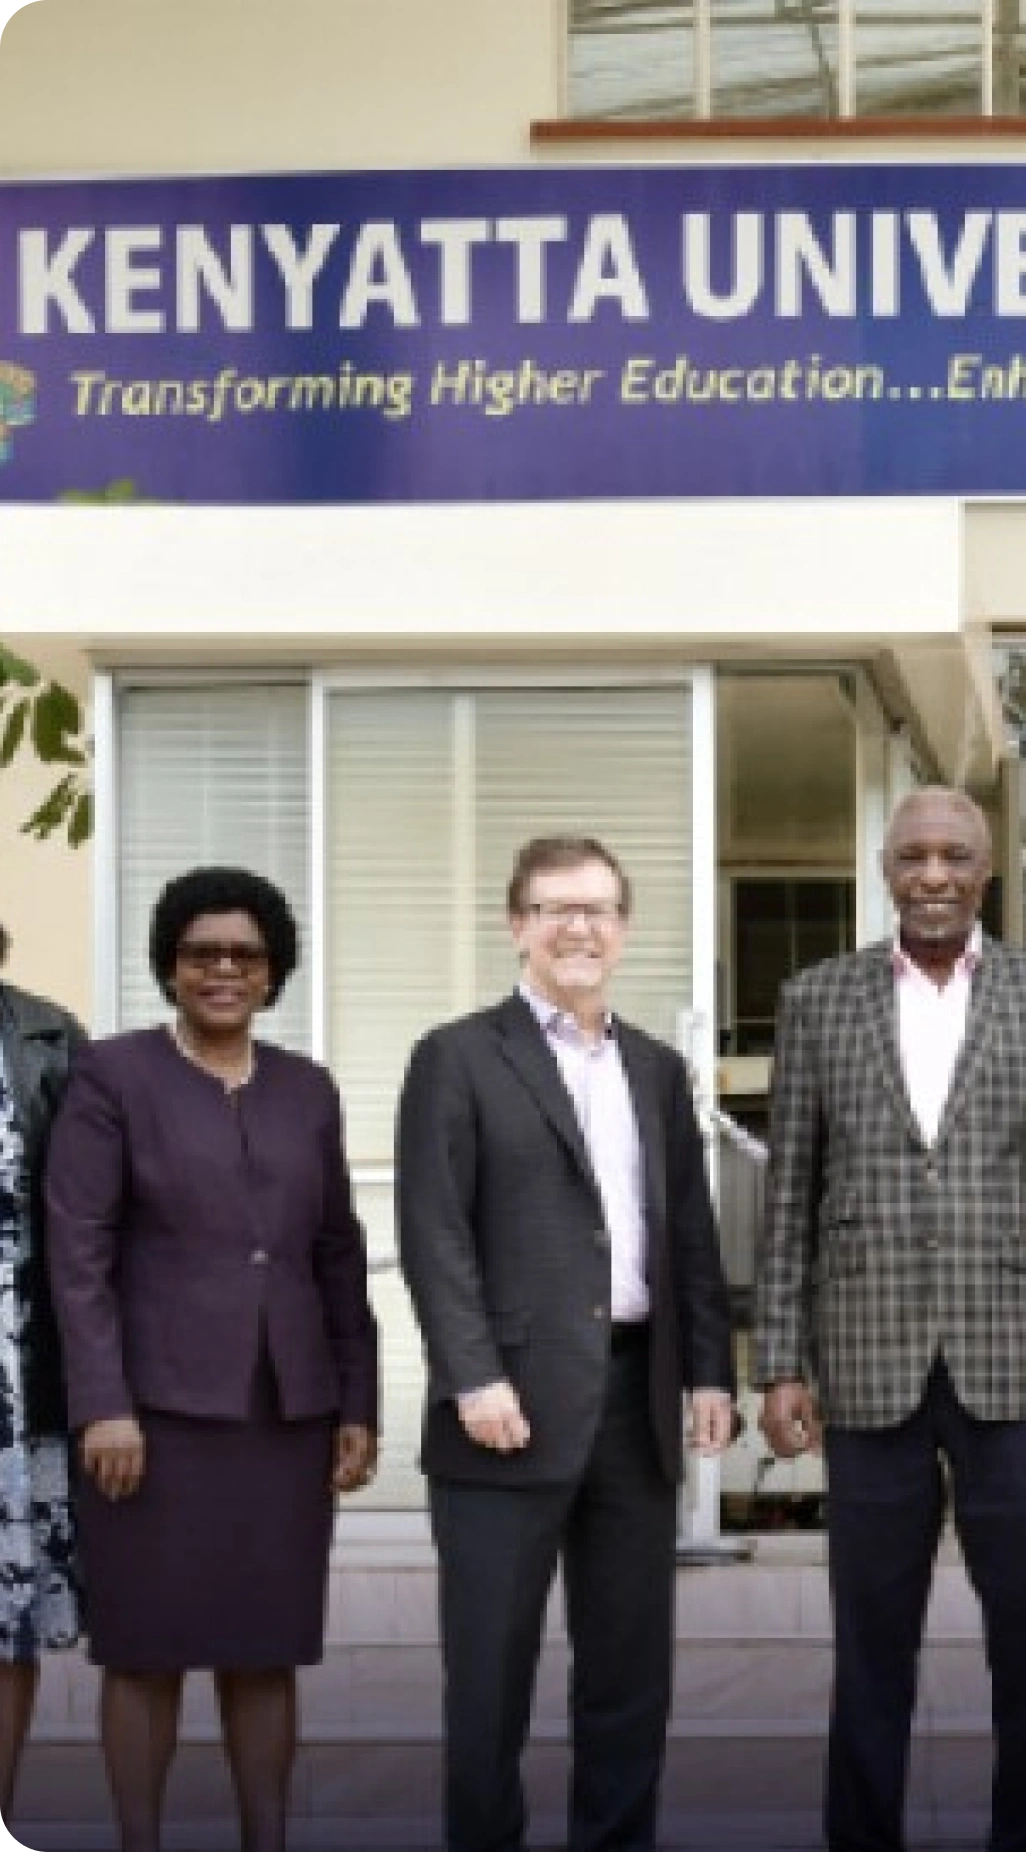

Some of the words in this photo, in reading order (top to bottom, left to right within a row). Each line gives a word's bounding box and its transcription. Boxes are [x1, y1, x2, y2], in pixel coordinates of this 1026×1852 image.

[17, 213, 650, 334] KENYATTA
[70, 361, 414, 421] Transforming
[431, 358, 603, 417] Higher
